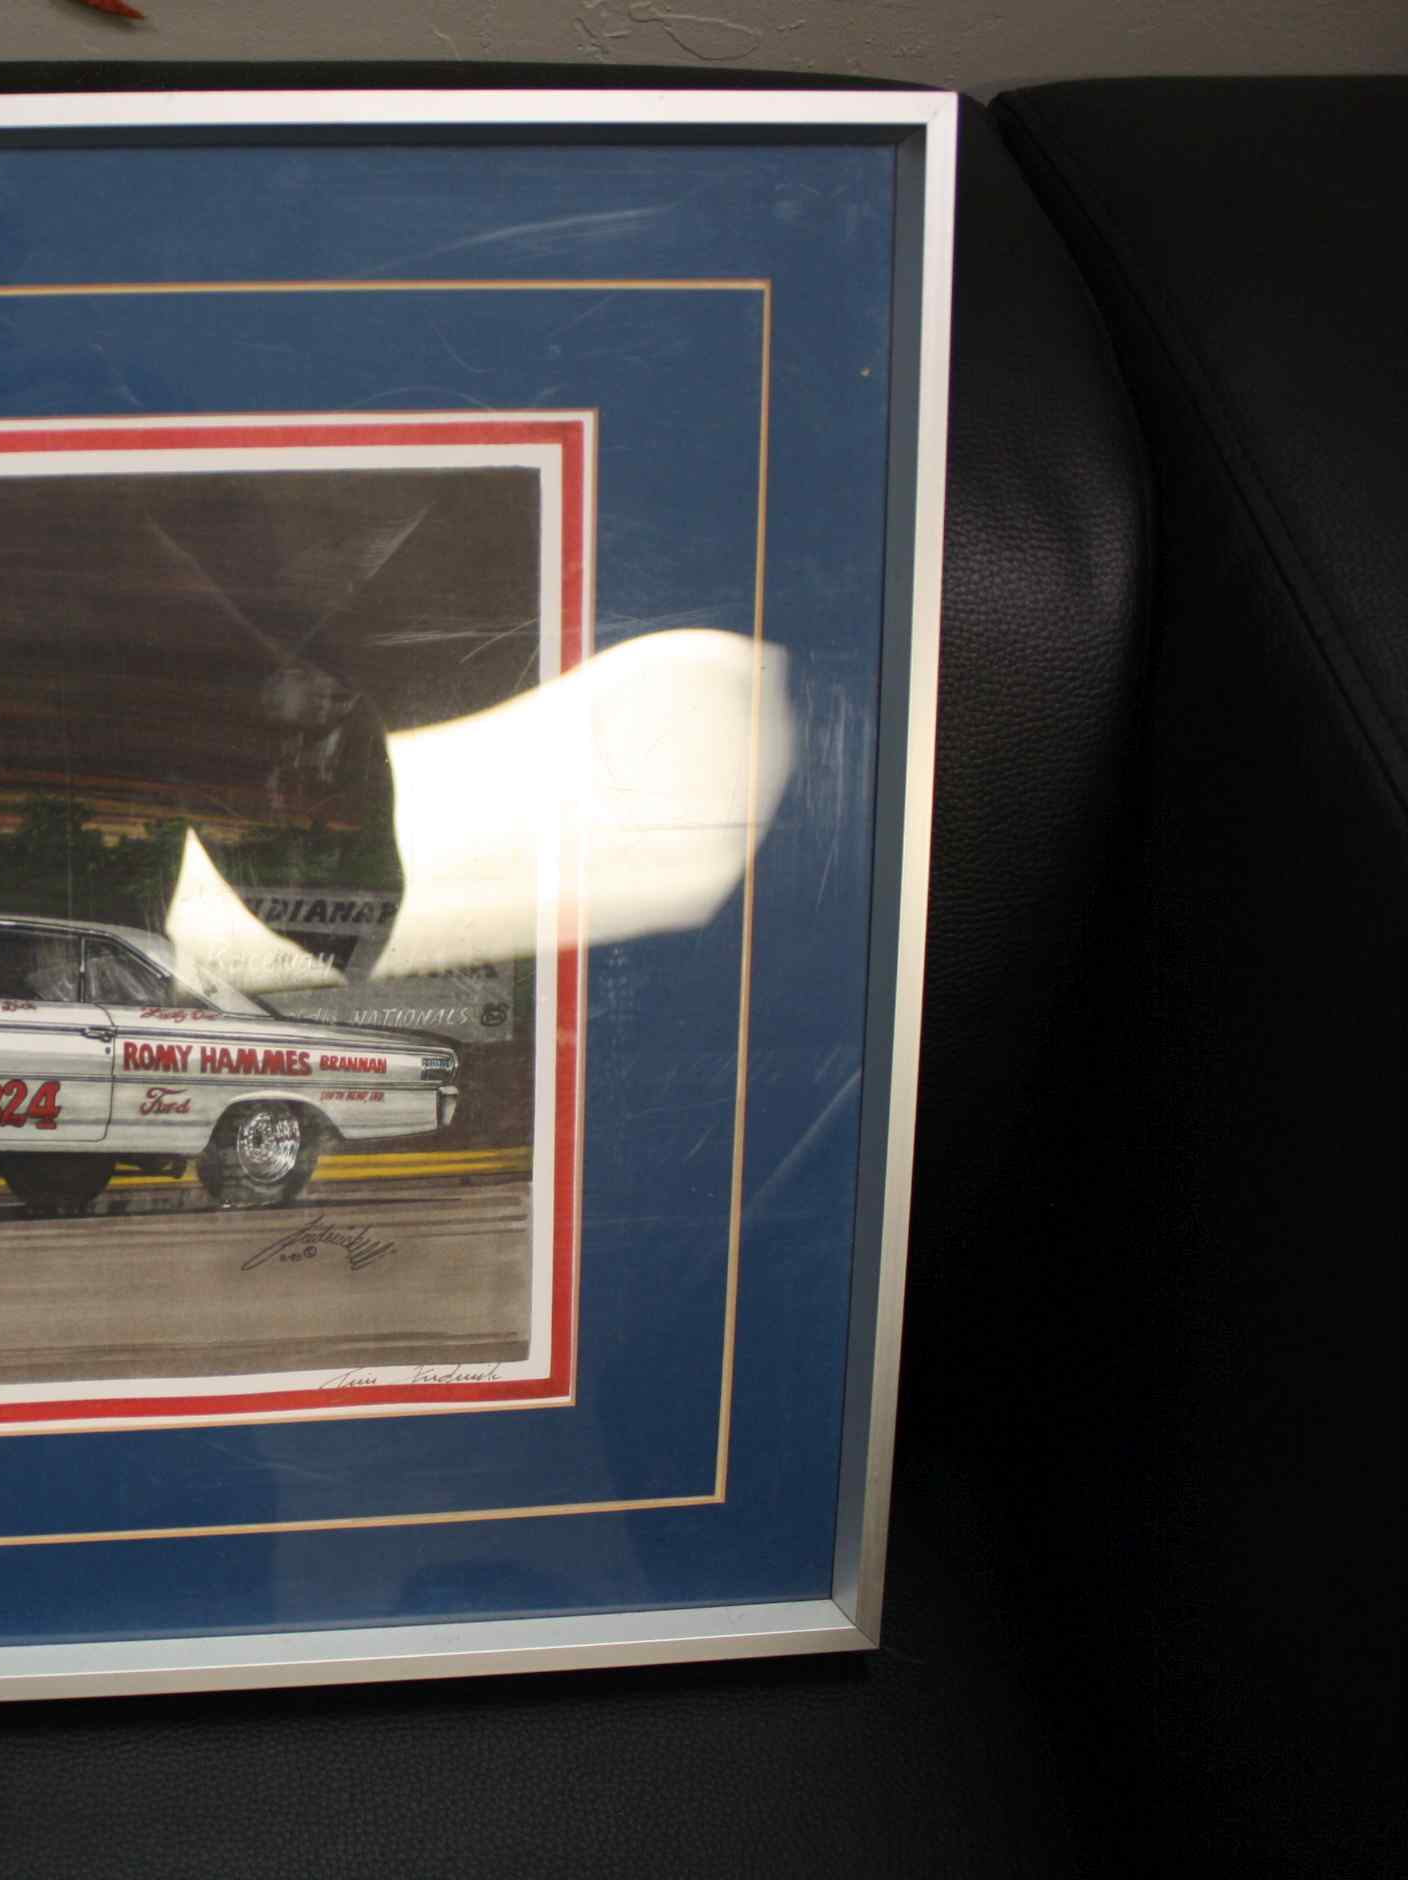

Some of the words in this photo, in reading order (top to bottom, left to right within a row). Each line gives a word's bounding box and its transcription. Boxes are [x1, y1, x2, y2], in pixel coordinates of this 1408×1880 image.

[123, 1041, 194, 1072] ROMY
[200, 1046, 312, 1077] HAMMES
[138, 1087, 192, 1116] Ford
